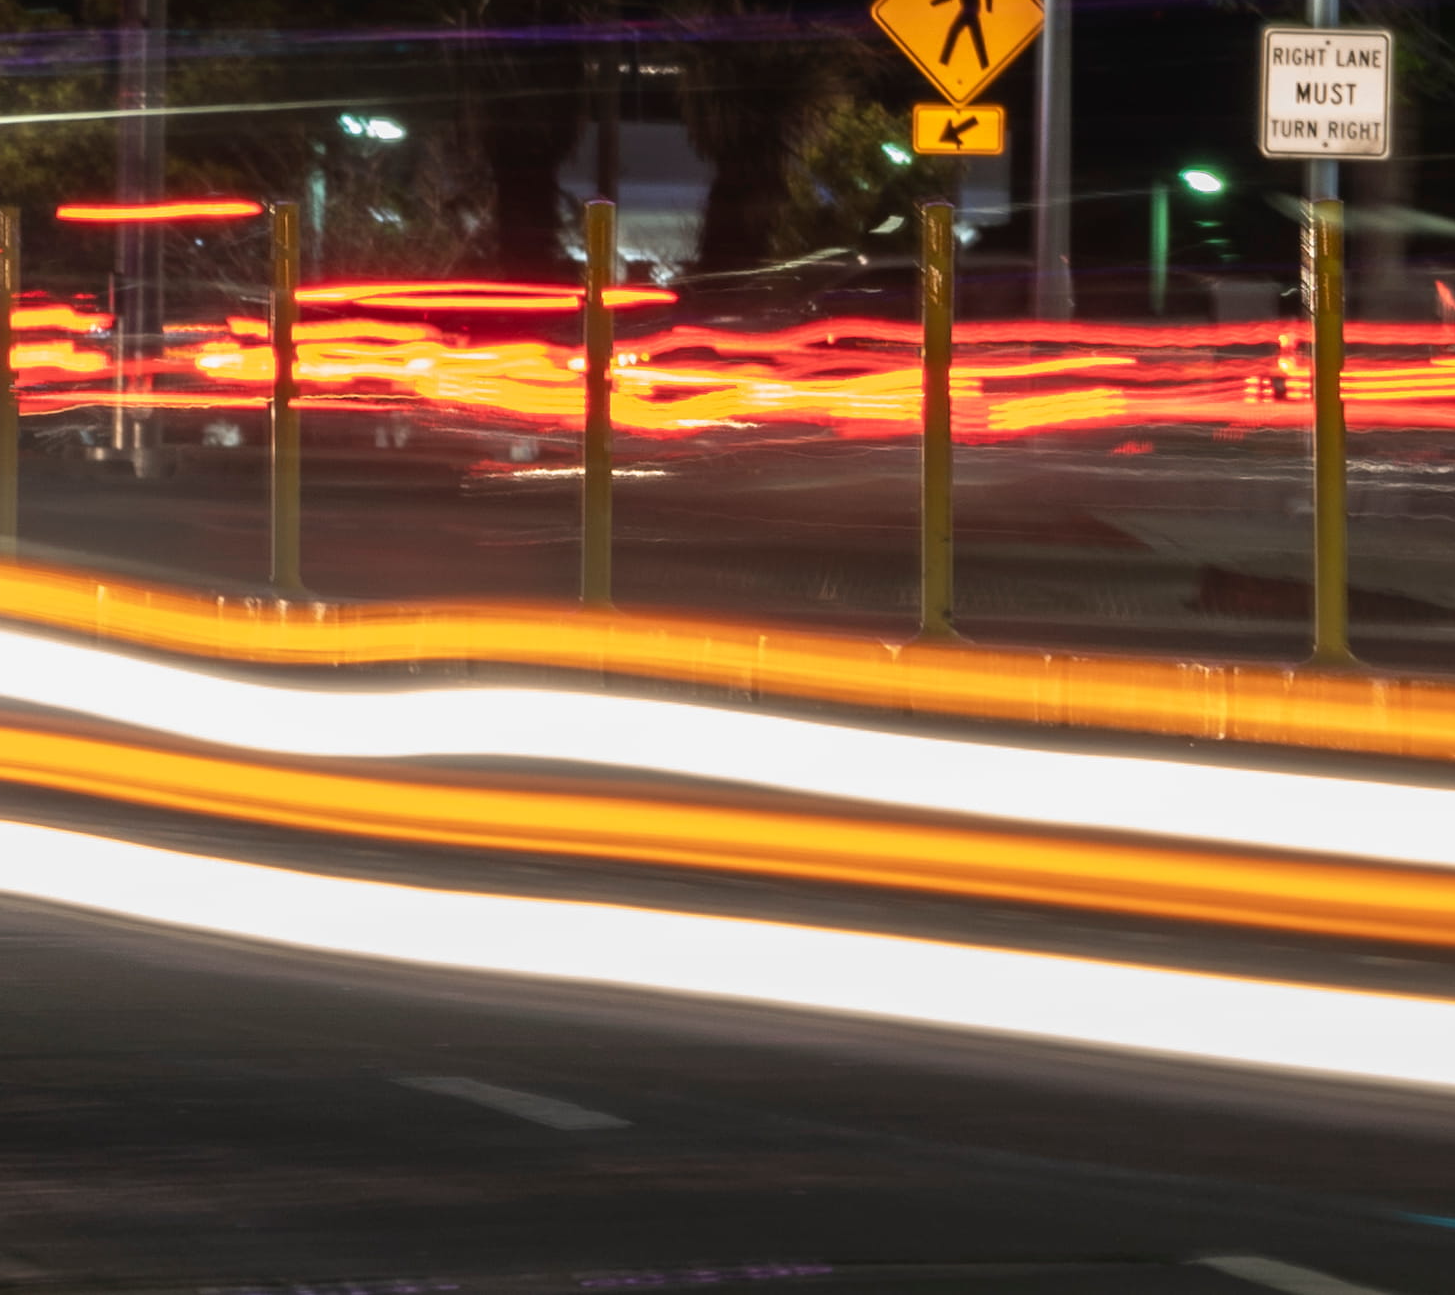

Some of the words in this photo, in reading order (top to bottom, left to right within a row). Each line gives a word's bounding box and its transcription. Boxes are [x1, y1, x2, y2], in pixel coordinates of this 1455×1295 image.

[1272, 47, 1326, 67] RIGHT
[1335, 49, 1382, 69] LANE
[1295, 82, 1357, 106] MUST
[1271, 119, 1318, 139] TURN
[1327, 121, 1381, 141] RIGHT
